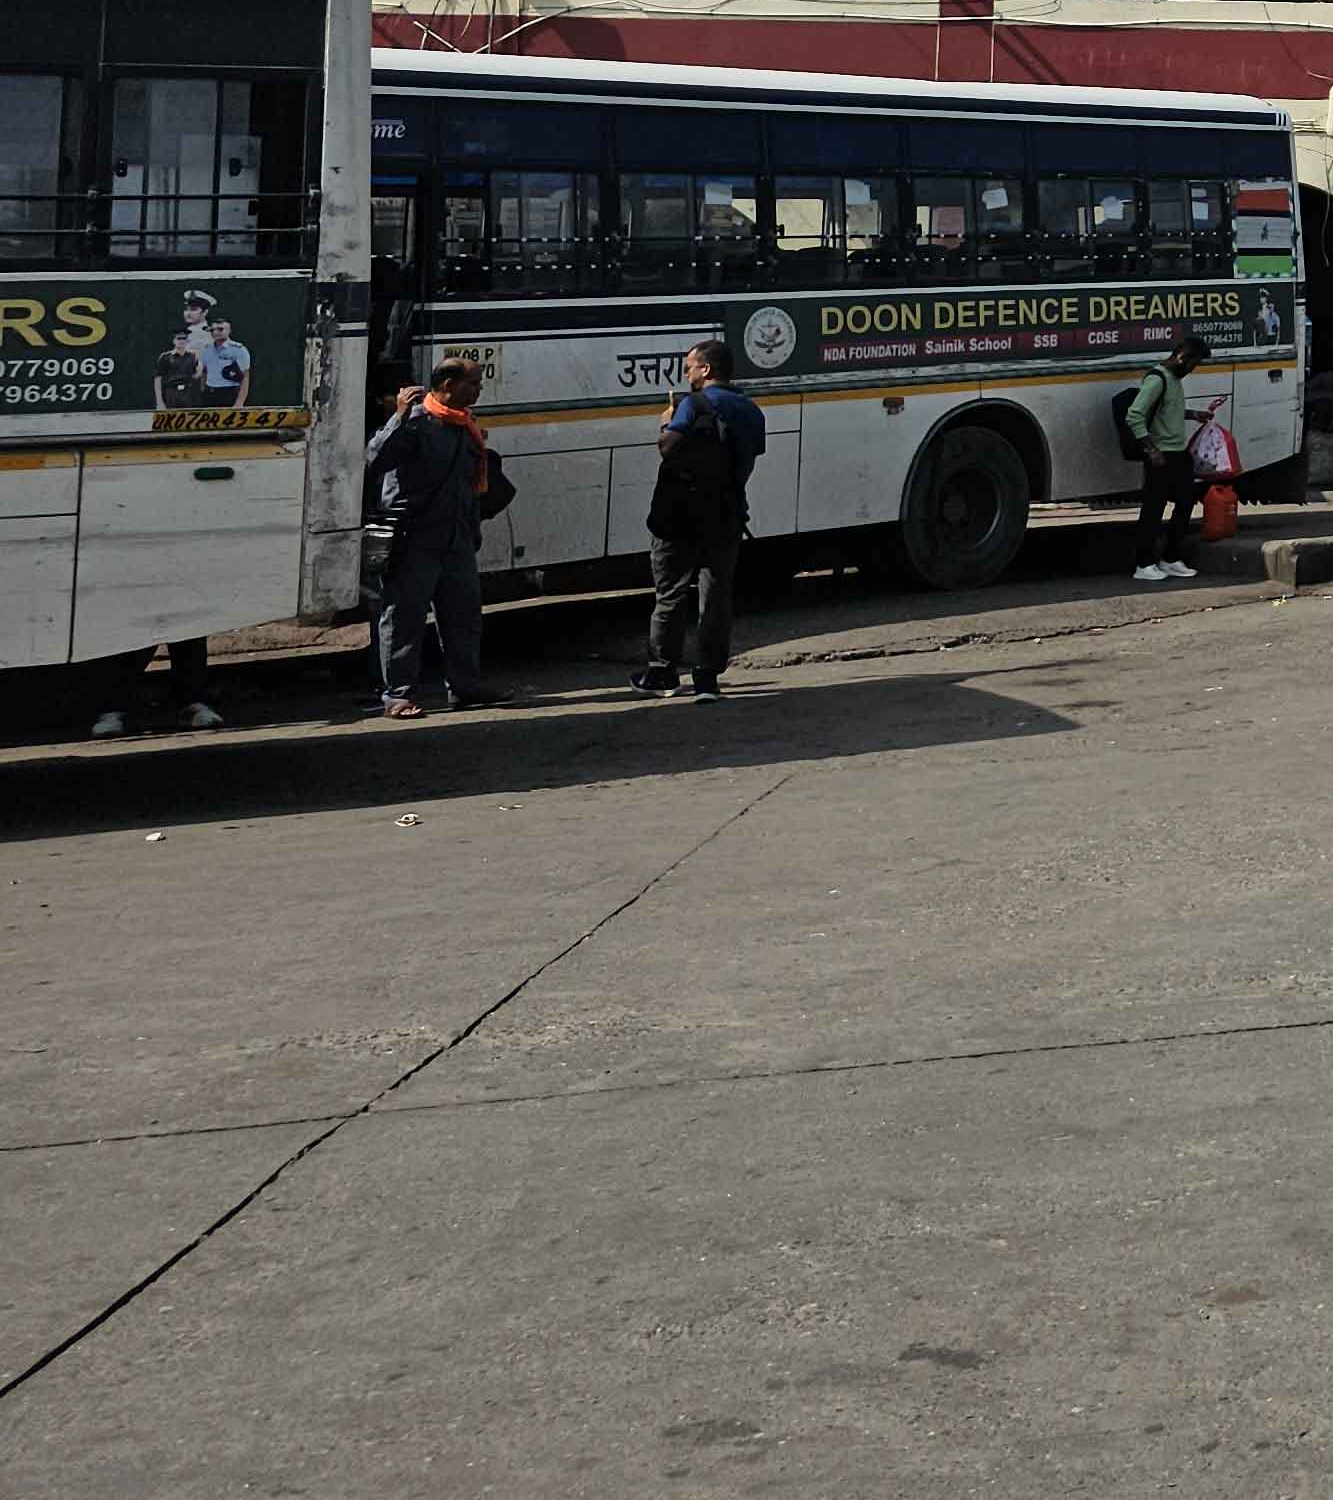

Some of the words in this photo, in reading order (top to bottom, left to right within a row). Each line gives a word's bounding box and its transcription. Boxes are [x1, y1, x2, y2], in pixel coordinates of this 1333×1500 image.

[820, 302, 922, 336] DOON
[933, 296, 1080, 330] DEFENCE
[1088, 290, 1241, 323] DREAMERS
[823, 347, 847, 362] NDA
[849, 343, 916, 361] FOUNDATION
[925, 338, 966, 355] Sainik
[968, 336, 1012, 352] School
[1033, 334, 1058, 349] SSB
[1143, 326, 1173, 341] RIMC
[616, 351, 690, 388] उत्तरा
